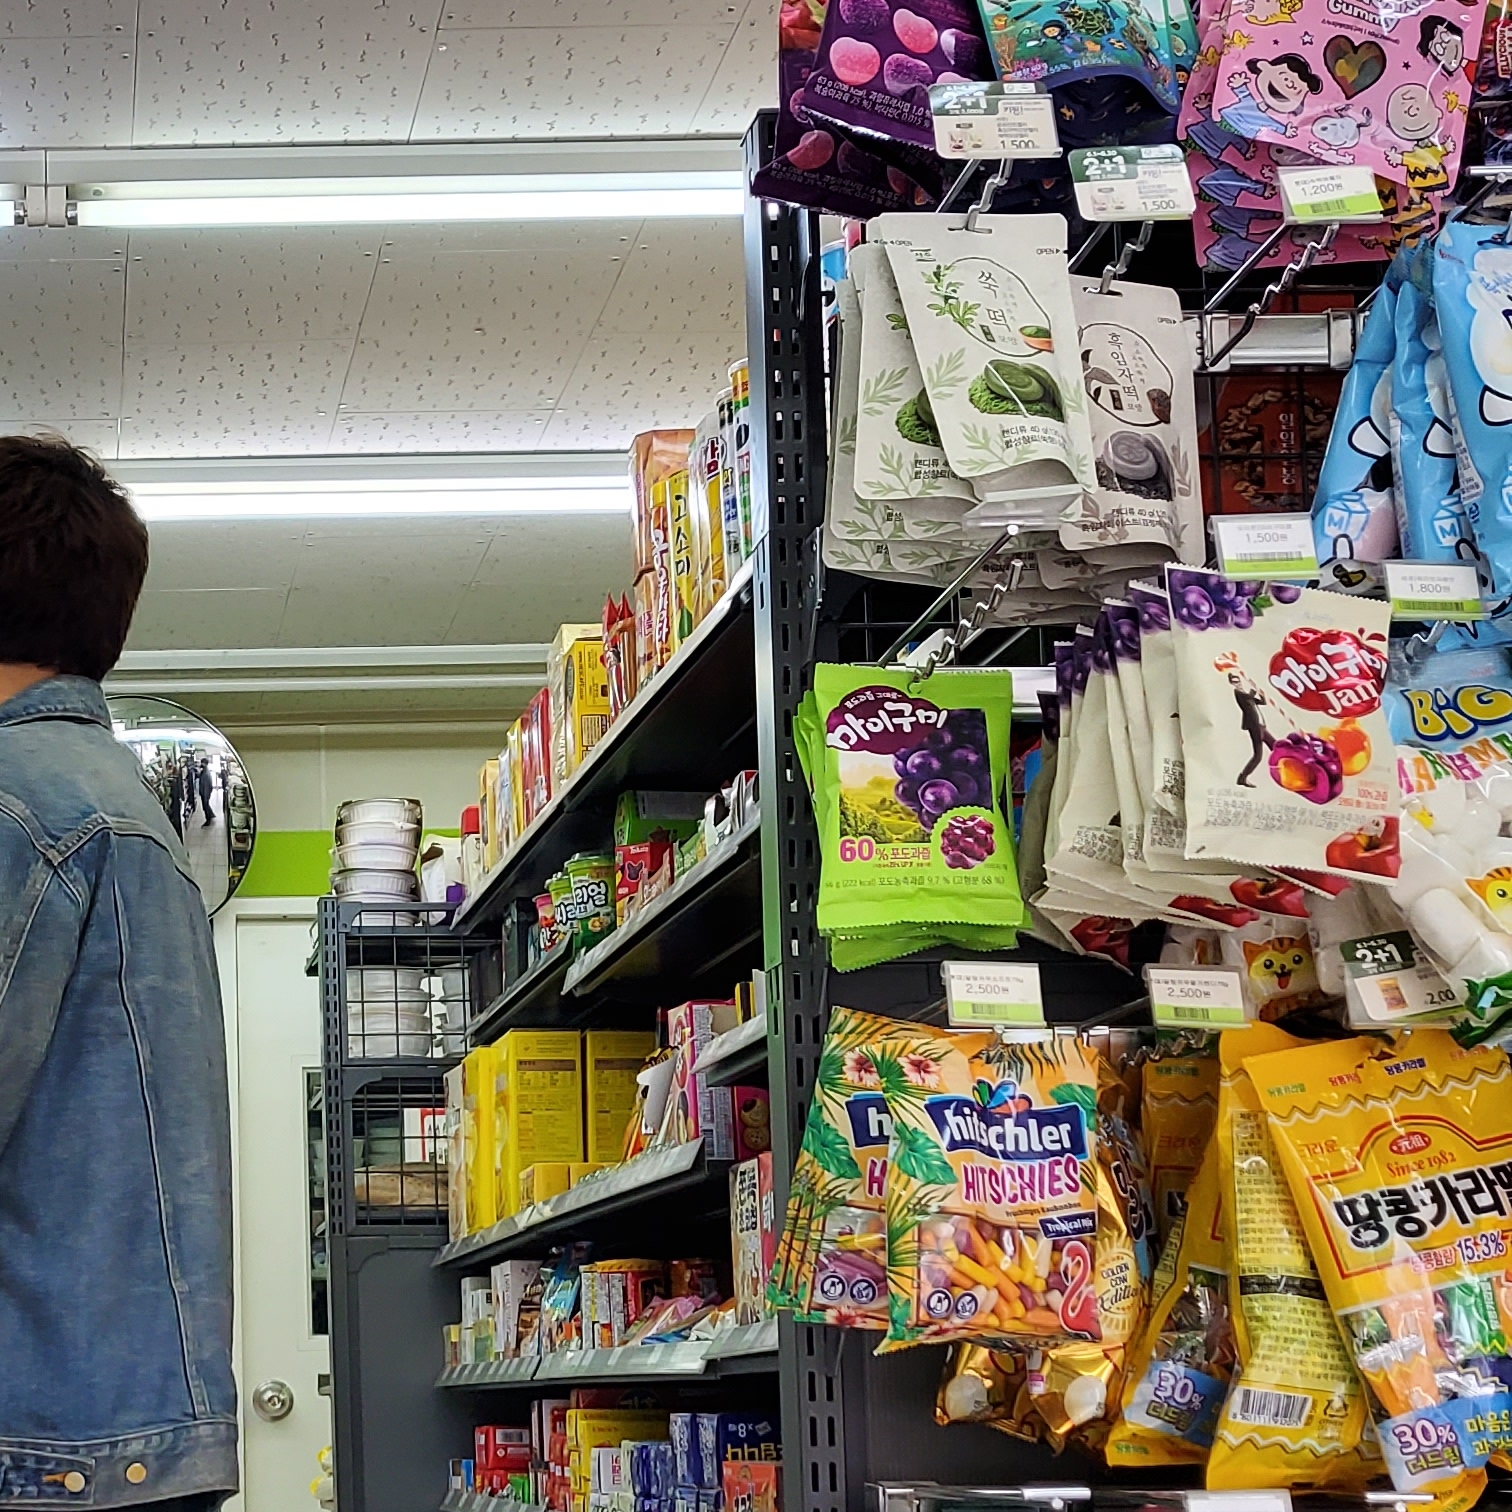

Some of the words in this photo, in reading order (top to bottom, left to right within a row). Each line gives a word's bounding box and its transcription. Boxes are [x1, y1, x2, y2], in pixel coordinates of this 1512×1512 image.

[1083, 156, 1128, 176] 2+1
[674, 493, 691, 576] 고소미
[826, 701, 948, 749] 마이구미
[840, 838, 874, 862] 60
[890, 846, 931, 860] 포도과즙
[1354, 947, 1404, 974] 2+1
[946, 1108, 1072, 1153] hitschler
[962, 1154, 1080, 1204] HITSCHIES
[1456, 1231, 1506, 1264] 15.3%
[1392, 1418, 1457, 1456] 30%
